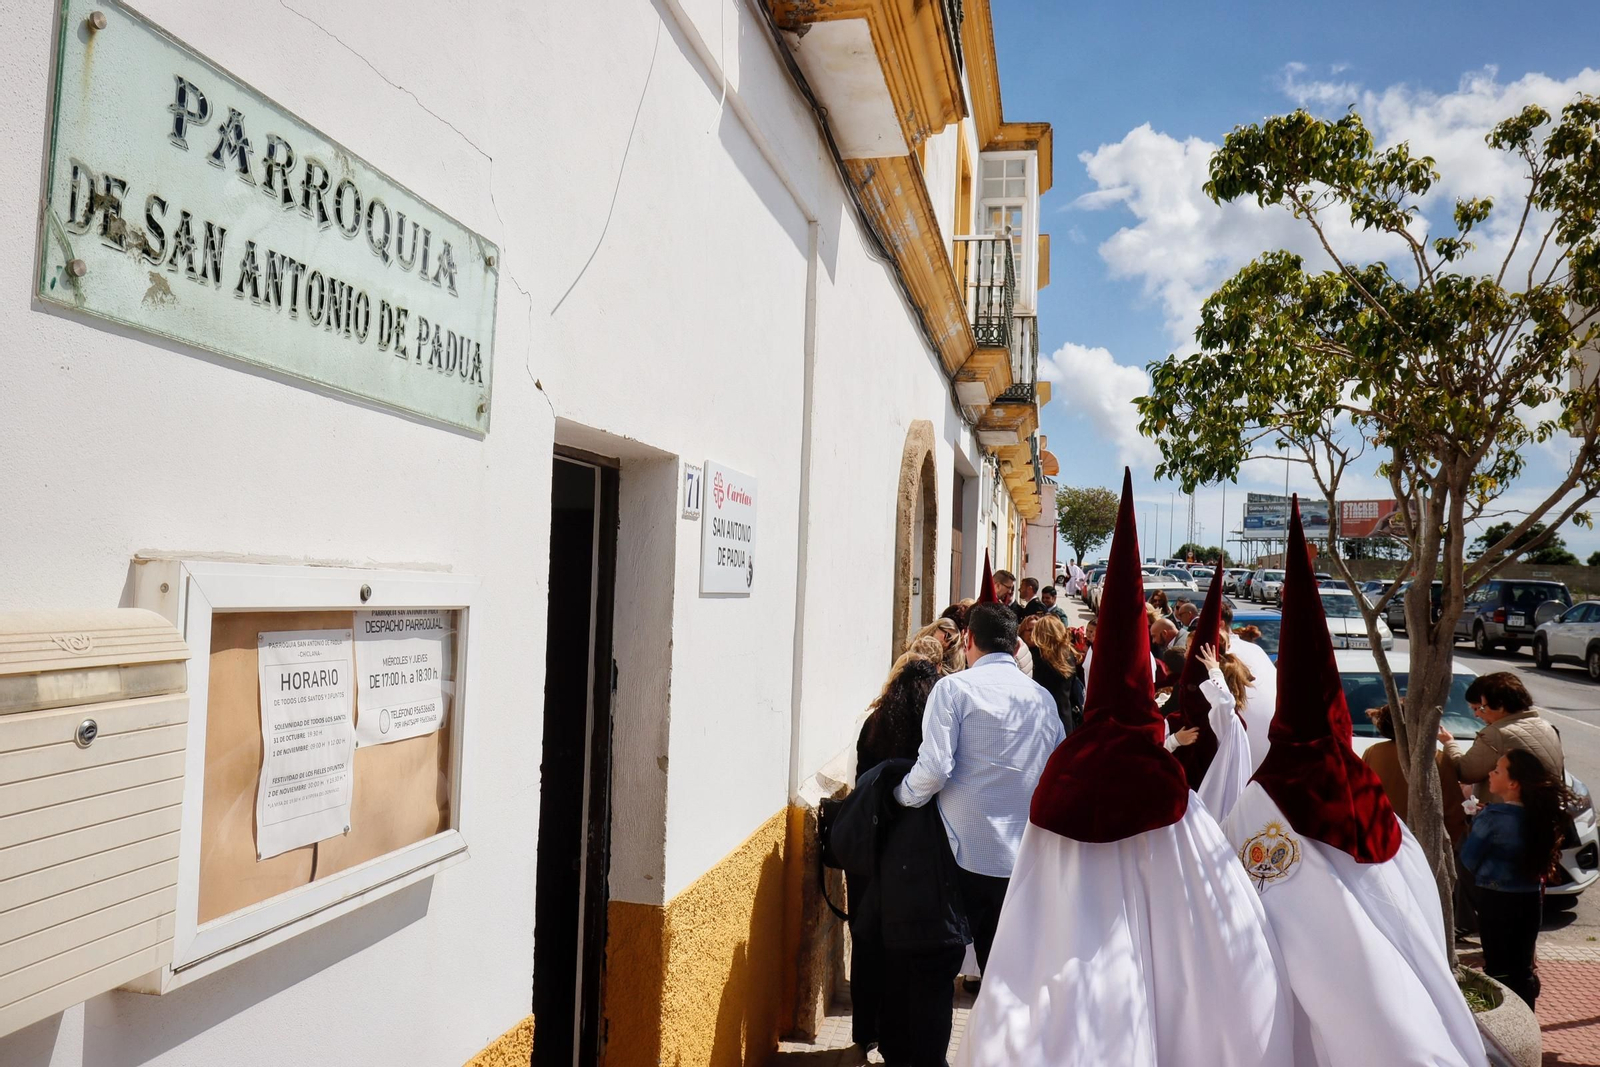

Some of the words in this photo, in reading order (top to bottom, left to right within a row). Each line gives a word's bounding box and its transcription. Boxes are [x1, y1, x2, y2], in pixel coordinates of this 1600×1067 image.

[168, 75, 458, 297] PARROQUIA
[67, 158, 130, 253] DE
[141, 193, 228, 289] SAN
[234, 239, 371, 343] ANTONIO
[377, 299, 410, 360] DE
[415, 315, 484, 386] PADUA
[687, 473, 700, 509] 71
[726, 483, 752, 506] Cáritas
[1343, 502, 1379, 512] STACKER
[712, 517, 725, 538] SAN
[726, 521, 752, 543] ANTONIO
[717, 546, 726, 566] DE
[726, 548, 746, 568] PADUA
[365, 619, 404, 633] DESPACHO
[405, 618, 443, 631] PARROQUIAL
[268, 641, 297, 649] PARROQUIA
[382, 655, 409, 666] MIÉRCOLES
[413, 653, 428, 664] JUEVES
[280, 668, 338, 691] HORARIO
[369, 674, 381, 689] DE
[382, 671, 399, 687] 17:00
[401, 671, 407, 685] h.
[409, 674, 414, 684] a
[415, 668, 432, 682] 18:30
[433, 668, 438, 680] h.
[281, 698, 297, 706] TODOS
[308, 694, 324, 702] SANTOS
[391, 708, 413, 719] TELÉFONO
[274, 720, 304, 730] SOLEMNIDAD
[286, 732, 306, 741] OCTUBRE
[283, 744, 308, 755] NOVIEMBRE
[272, 773, 298, 784] FESTIVIDAD
[314, 767, 327, 776] FIELES
[280, 784, 307, 795] NOVIEMBRE
